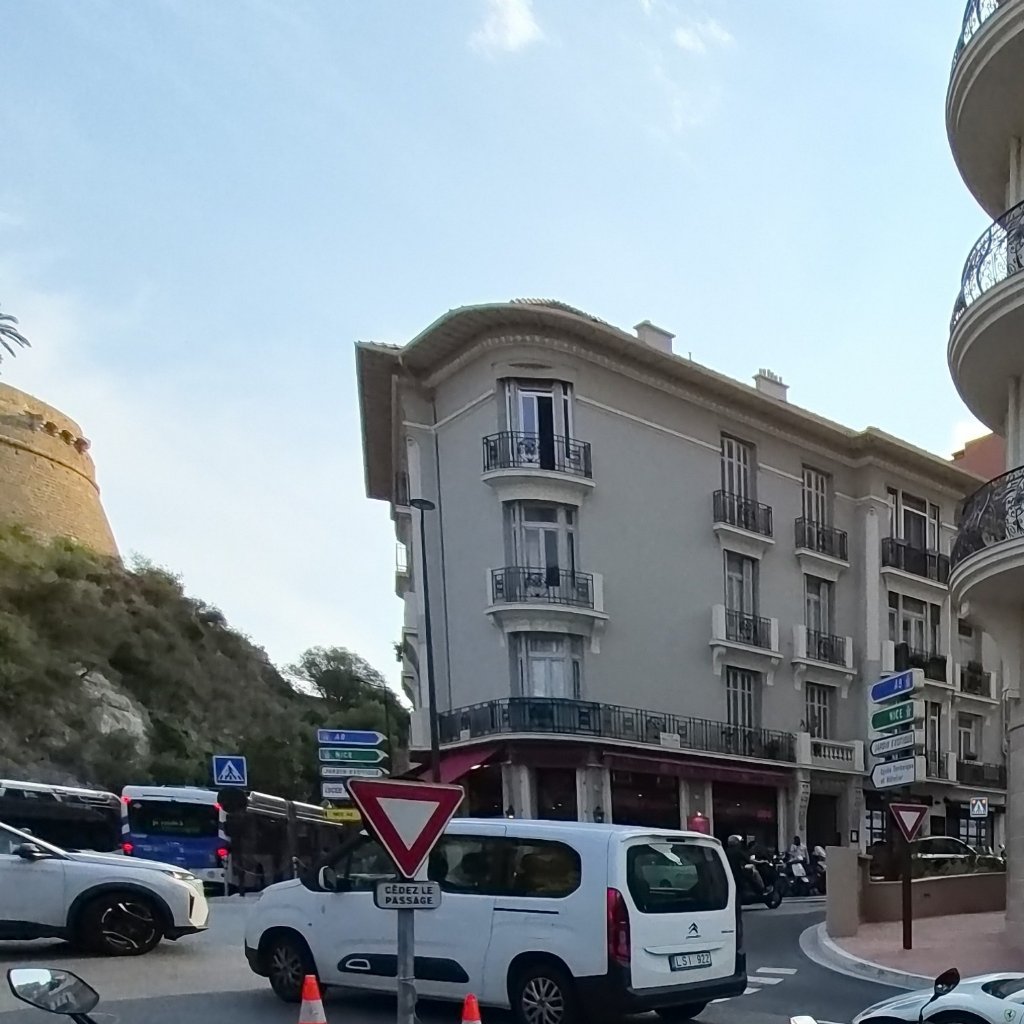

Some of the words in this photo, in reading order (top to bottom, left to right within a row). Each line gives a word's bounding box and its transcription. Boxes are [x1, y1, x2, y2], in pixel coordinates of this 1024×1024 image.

[889, 708, 903, 721] NICE
[335, 751, 353, 759] NICE
[422, 886, 433, 895] LE
[385, 896, 434, 904] PASSAGE
[697, 953, 710, 964] 922
